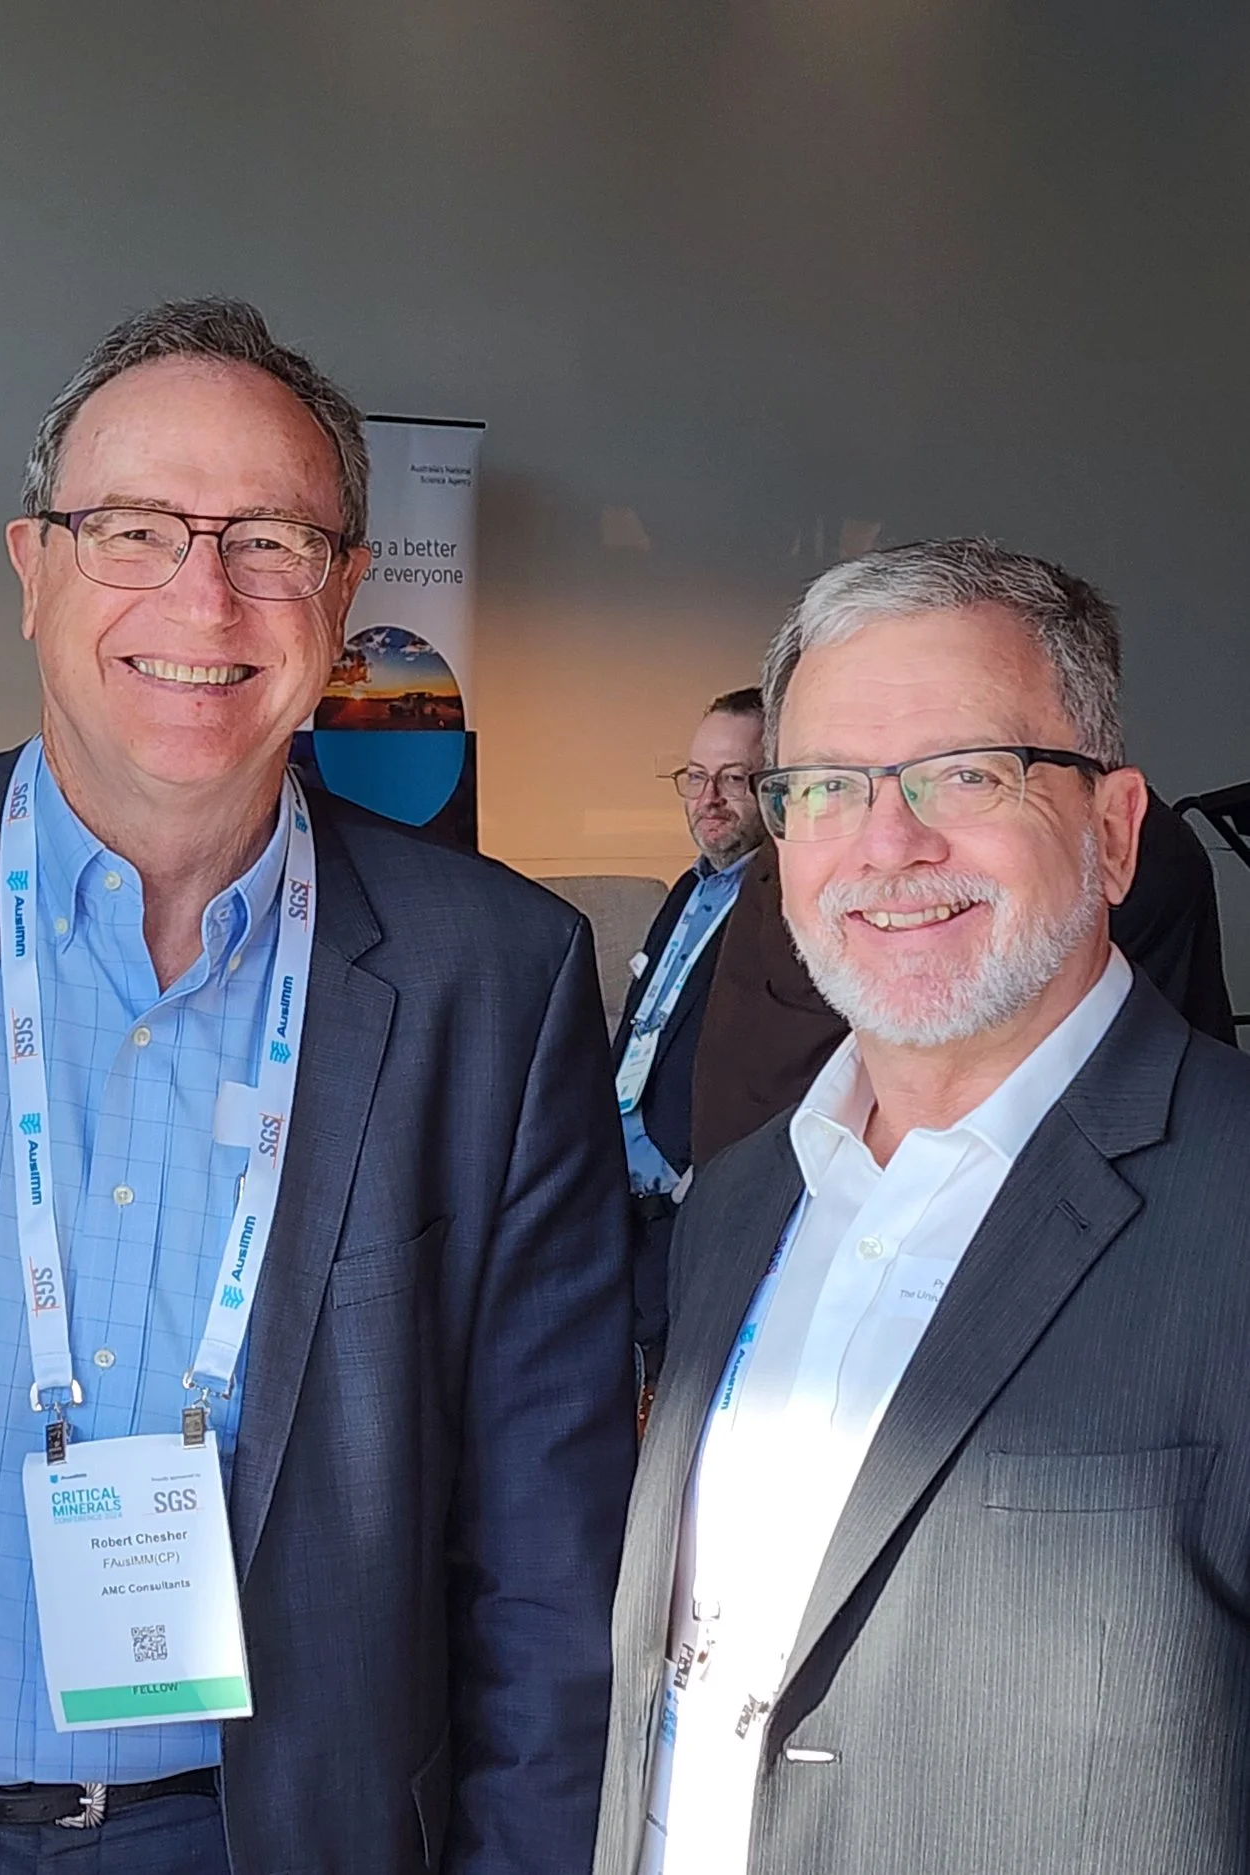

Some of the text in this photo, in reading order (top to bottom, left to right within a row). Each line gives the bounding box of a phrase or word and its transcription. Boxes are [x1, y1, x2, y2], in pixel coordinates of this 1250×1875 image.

[388, 541, 398, 556] a
[403, 538, 457, 558] better
[384, 567, 463, 587] everyone
[13, 1016, 35, 1057] SGS
[258, 1113, 282, 1157] SGS
[32, 1266, 56, 1308] SGS
[51, 1486, 120, 1506] CRITICAL
[153, 1488, 198, 1514] SGS
[52, 1499, 123, 1518] MINERALS
[91, 1530, 188, 1549] Robert Chesher
[101, 1578, 191, 1596] AMC Consultants
[132, 1682, 179, 1696] FELLOW
